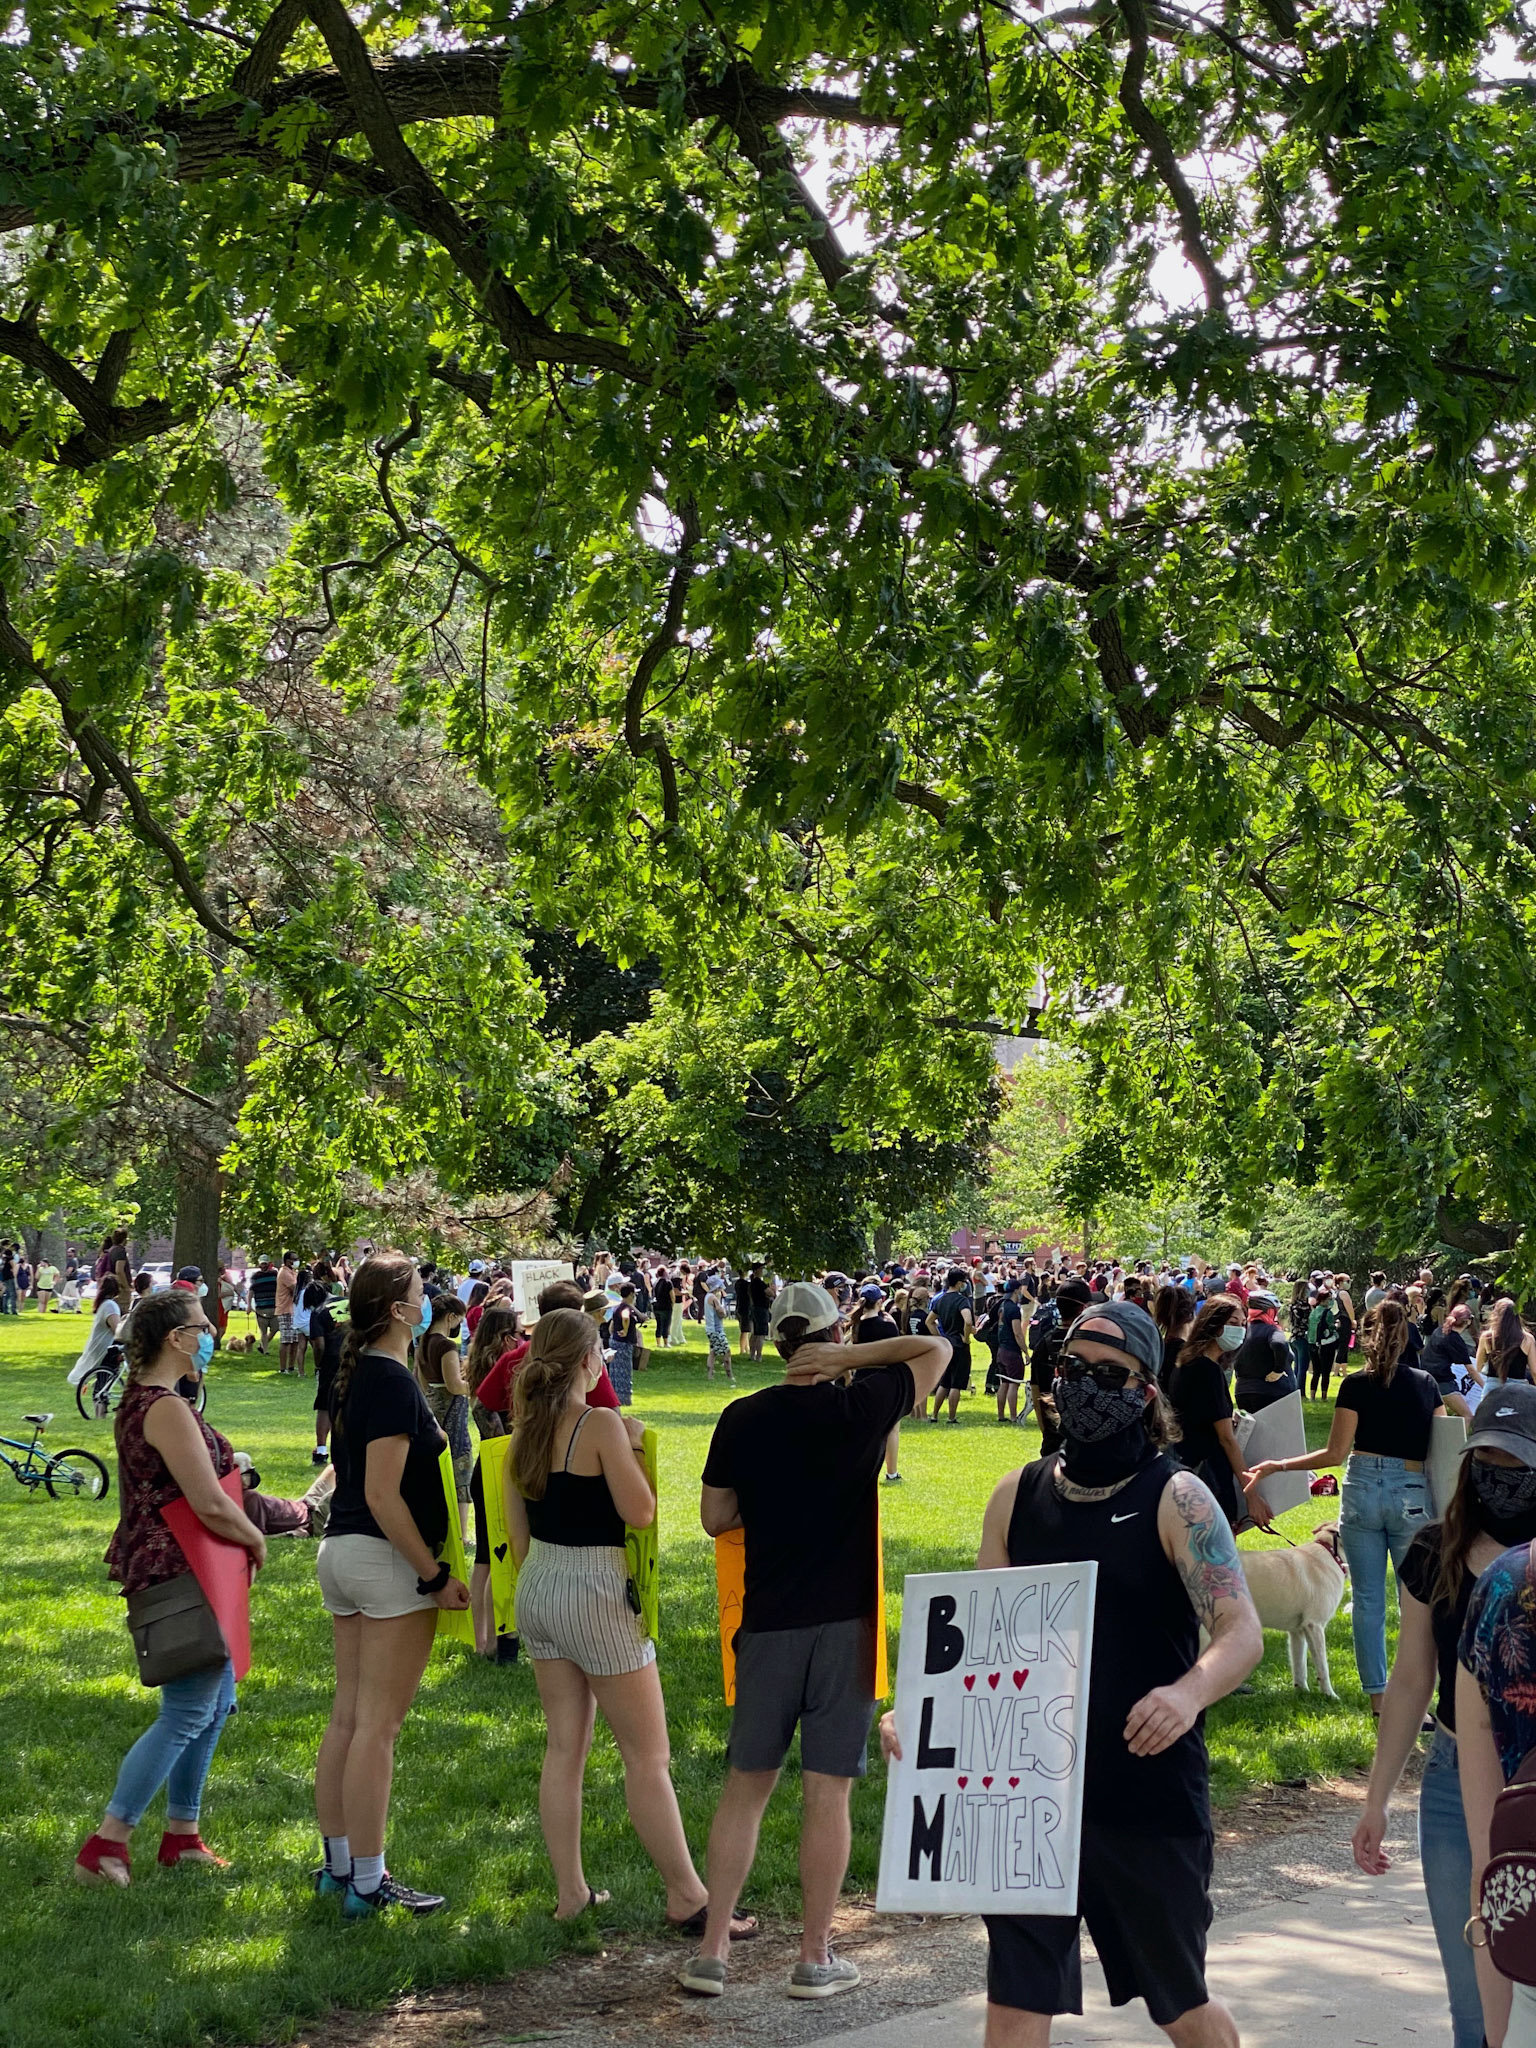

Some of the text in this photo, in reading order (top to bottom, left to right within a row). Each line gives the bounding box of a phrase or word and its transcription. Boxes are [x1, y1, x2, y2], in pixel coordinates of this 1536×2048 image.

[526, 1269, 559, 1282] BLACK
[924, 1580, 1079, 1675] BLACK
[916, 1695, 1078, 1781] LIVES
[908, 1793, 1065, 1892] MATTER
